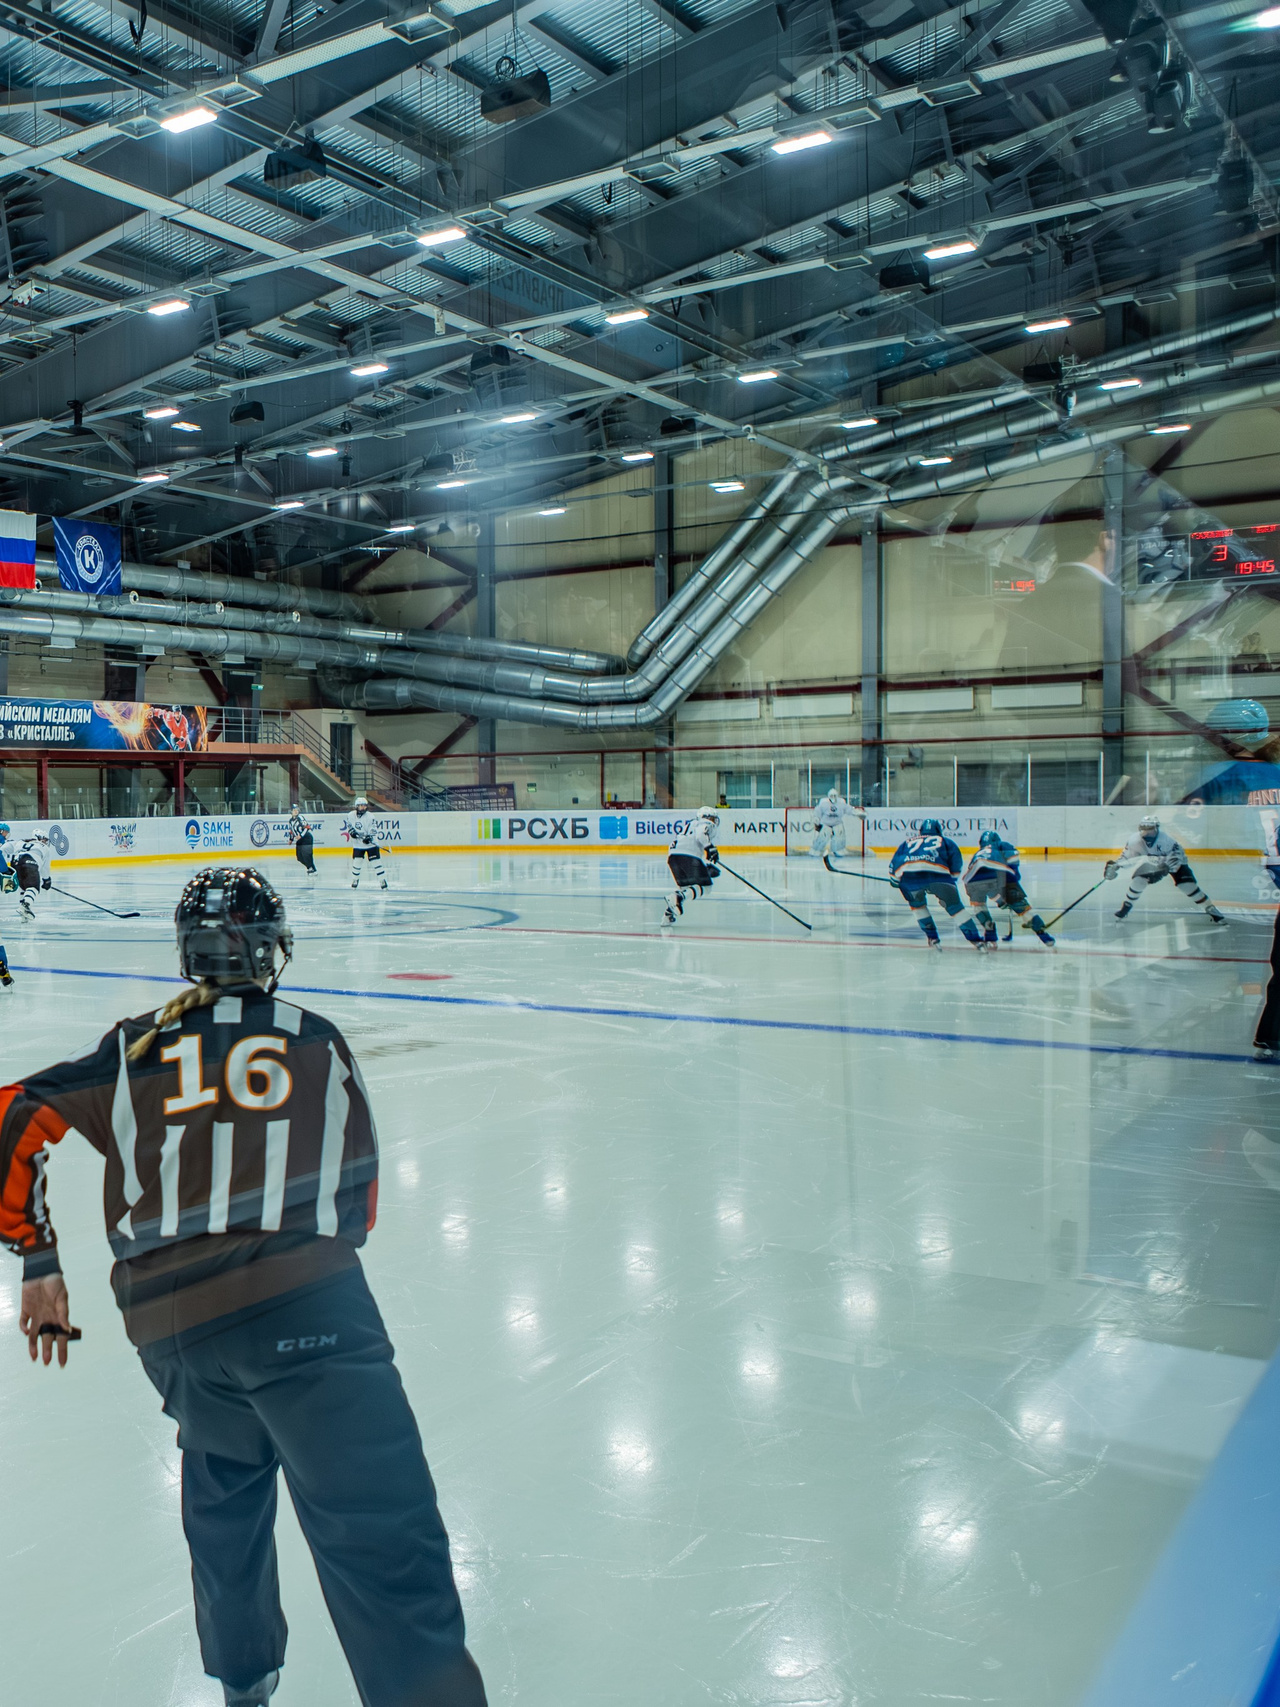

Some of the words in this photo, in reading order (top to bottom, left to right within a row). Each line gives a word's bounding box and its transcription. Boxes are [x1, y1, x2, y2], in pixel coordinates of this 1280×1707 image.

[1212, 544, 1228, 562] 3
[43, 707, 92, 724] МЕДАЛЯМ
[7, 725, 75, 742] «КРИСТАЛЛЕ»
[203, 822, 234, 835] SAKH.
[508, 818, 590, 840] РСХБ
[966, 818, 1009, 831] ТЕЛА
[203, 836, 233, 847] ONLINE
[160, 1034, 293, 1115] 16
[277, 1333, 338, 1353] CCM
